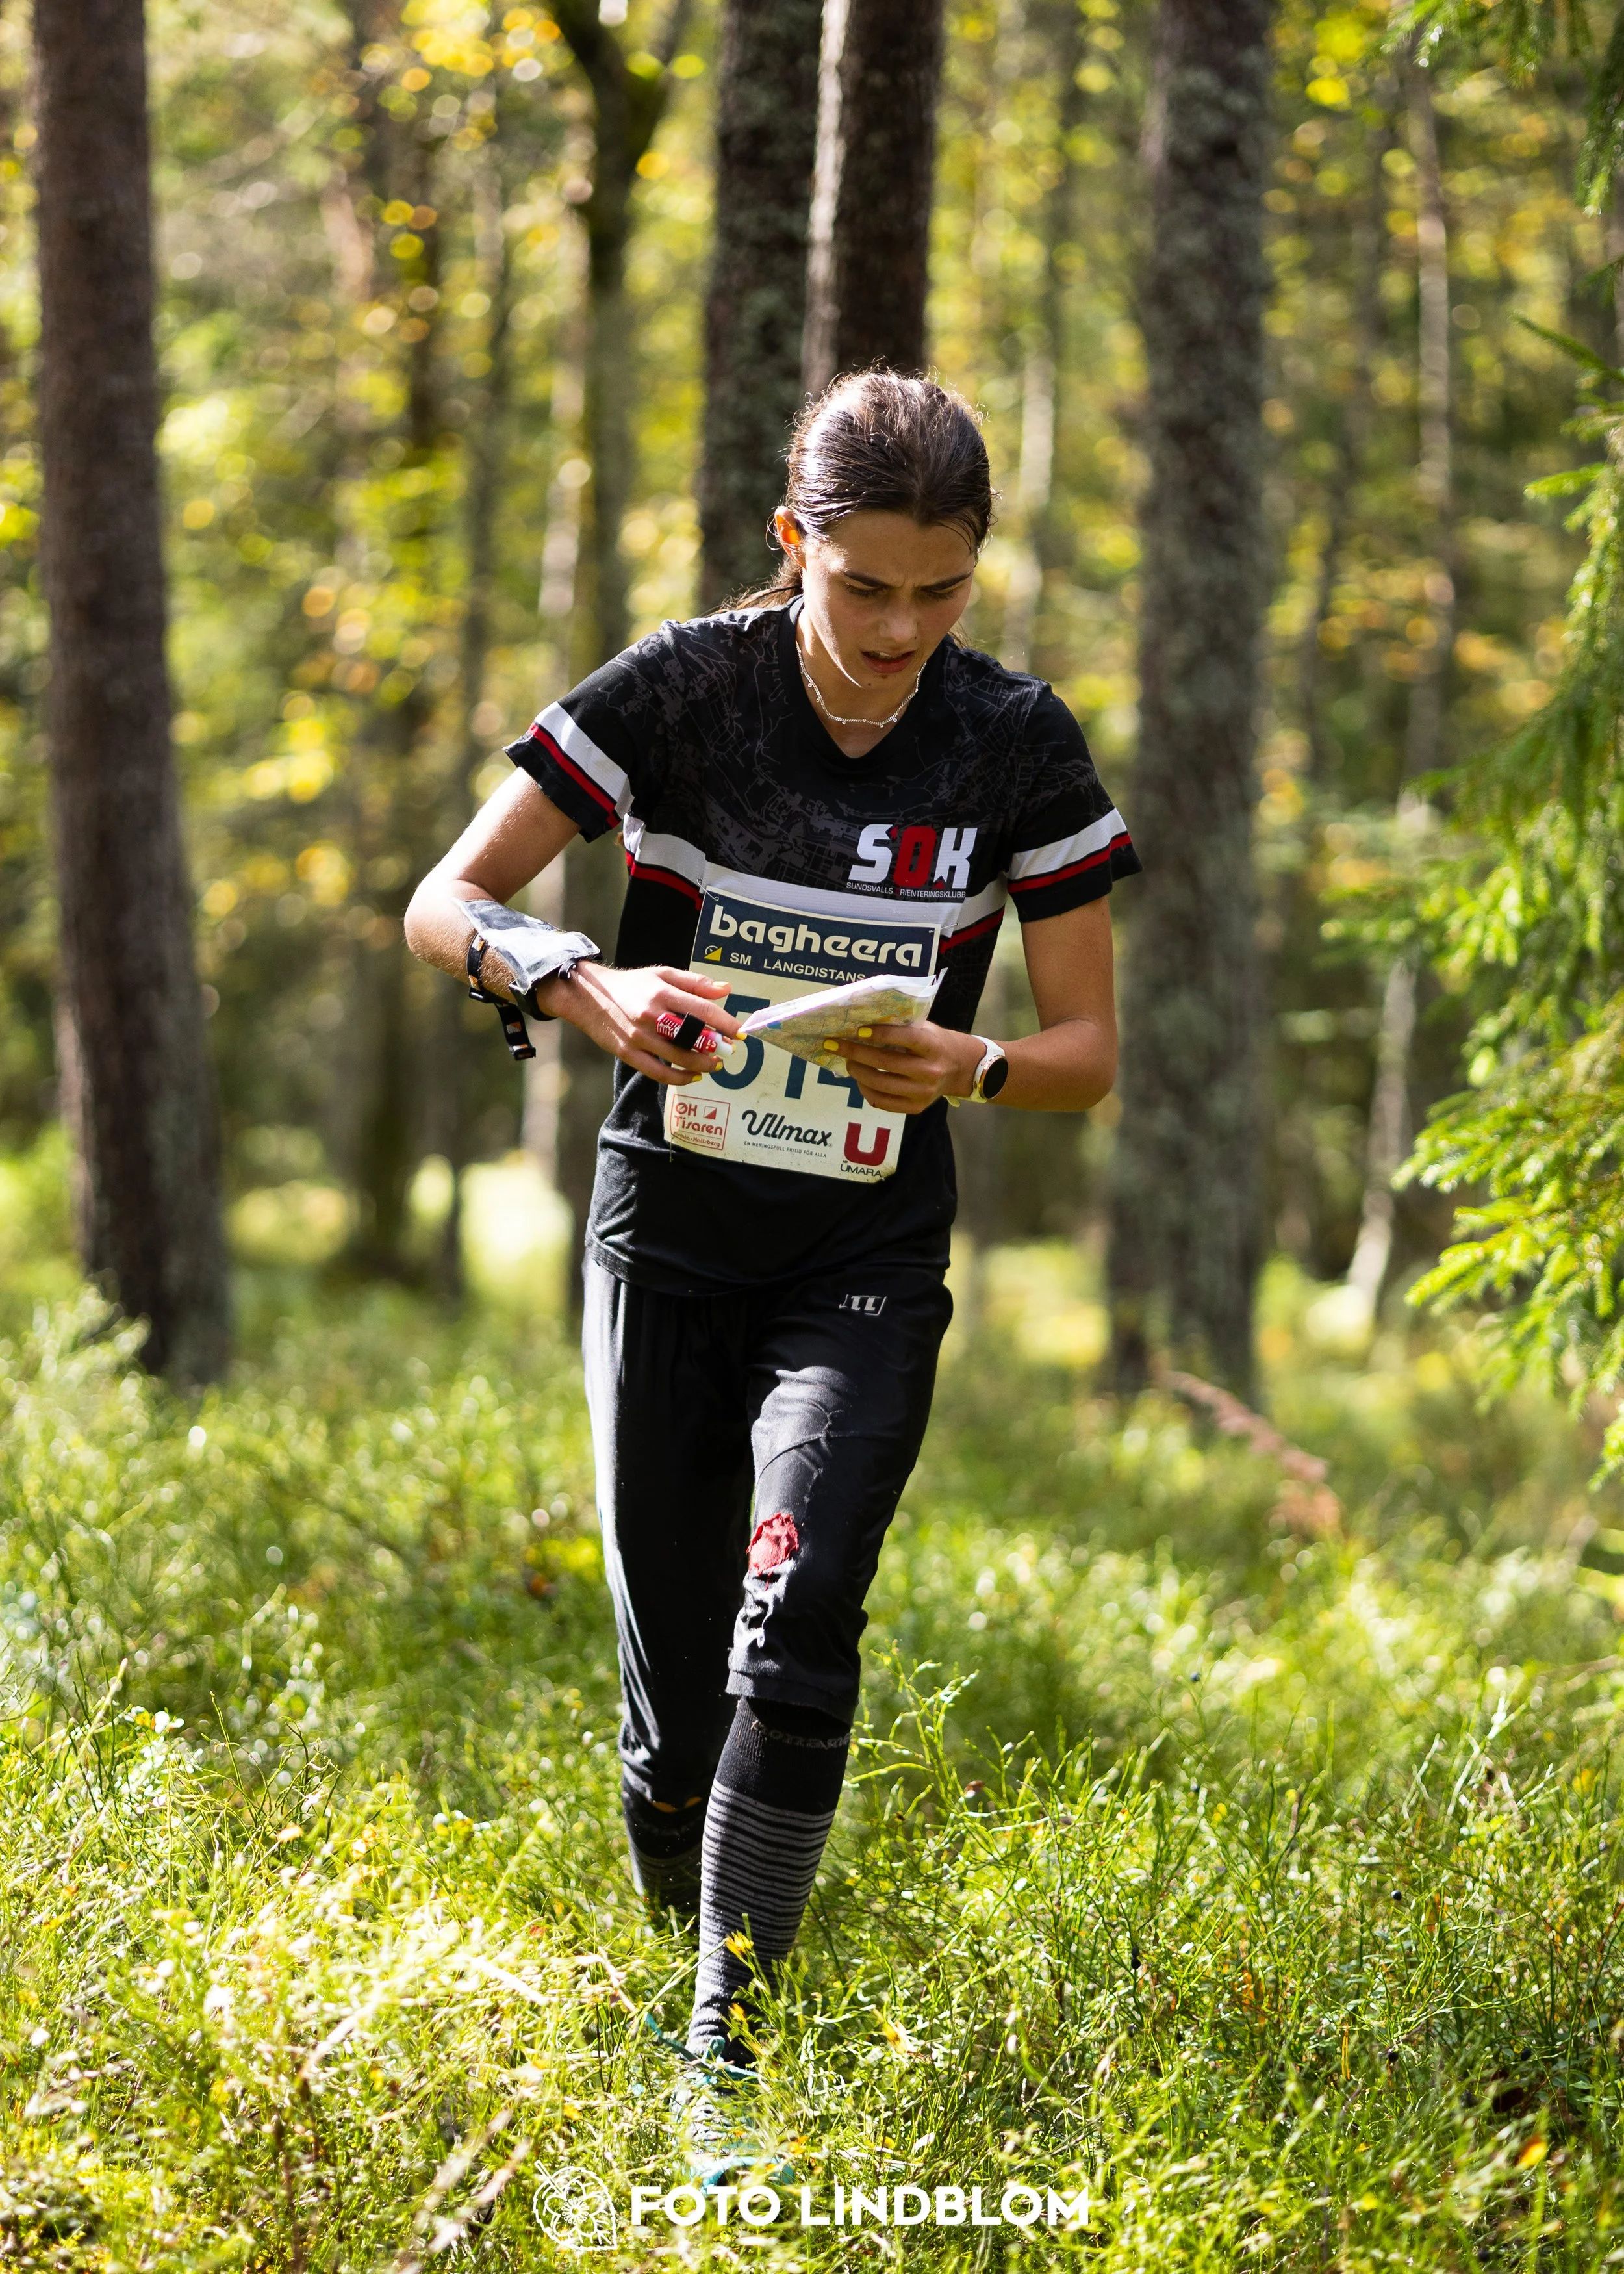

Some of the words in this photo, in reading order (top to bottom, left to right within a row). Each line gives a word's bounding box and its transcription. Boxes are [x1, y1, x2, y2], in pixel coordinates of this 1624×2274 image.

[848, 824, 978, 889] SOK
[846, 882, 893, 895] SUNDSVALLS
[894, 887, 967, 899] RIENTERINGSKLUBB
[709, 904, 923, 967] bagheera
[730, 952, 752, 965] SM
[763, 958, 866, 982] LÅNGDISTANS
[674, 1115, 723, 1136] Tisaren
[742, 1109, 832, 1147] Ullmax
[752, 1142, 785, 1151] MENINGSFULL
